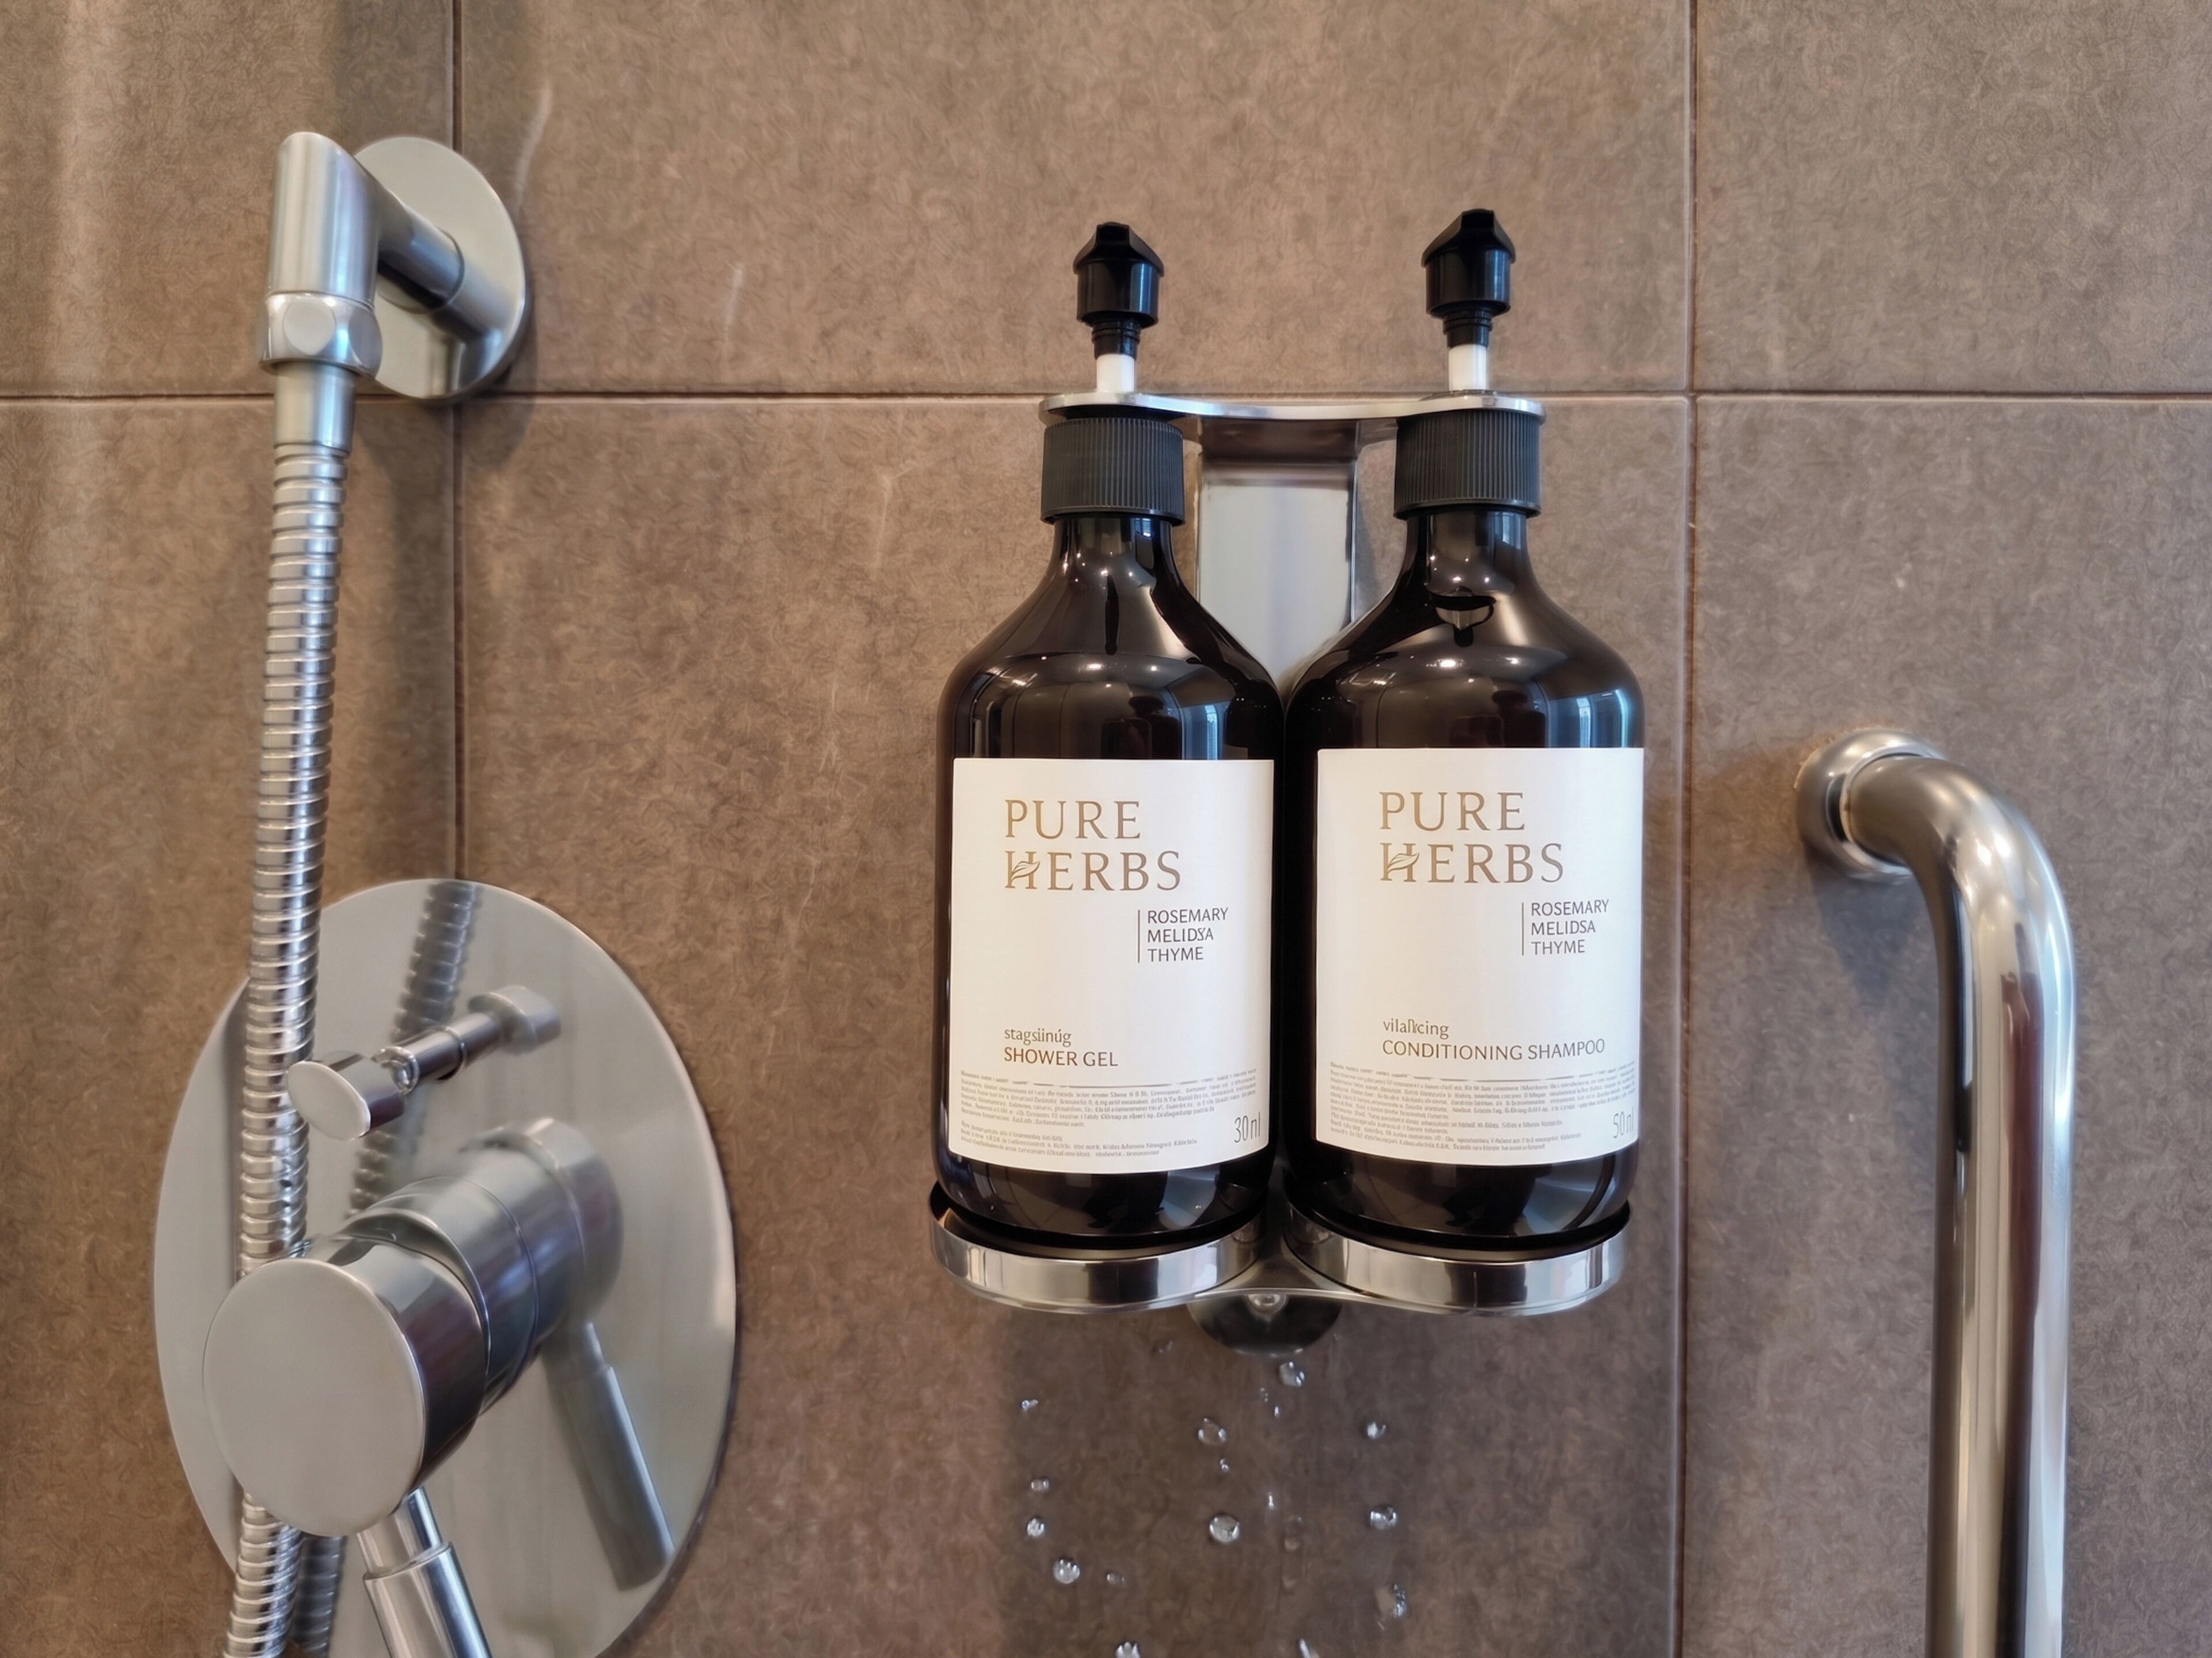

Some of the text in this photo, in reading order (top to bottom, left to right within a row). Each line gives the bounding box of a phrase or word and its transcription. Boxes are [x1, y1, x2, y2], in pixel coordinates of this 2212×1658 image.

[1005, 799, 1141, 840] PURE
[1378, 791, 1525, 832] PURE
[1004, 850, 1181, 891] HERBS
[1380, 842, 1564, 884] HERBS
[1147, 907, 1229, 924] ROSEMARY
[1531, 899, 1609, 916] ROSEMARY
[1531, 920, 1596, 936] MELIDSA
[1147, 946, 1203, 962] THYME
[1531, 939, 1585, 955] THYME
[1004, 1046, 1119, 1067] SHOWER GEL
[1382, 1038, 1605, 1060] CONDITIONING SHAMPOO
